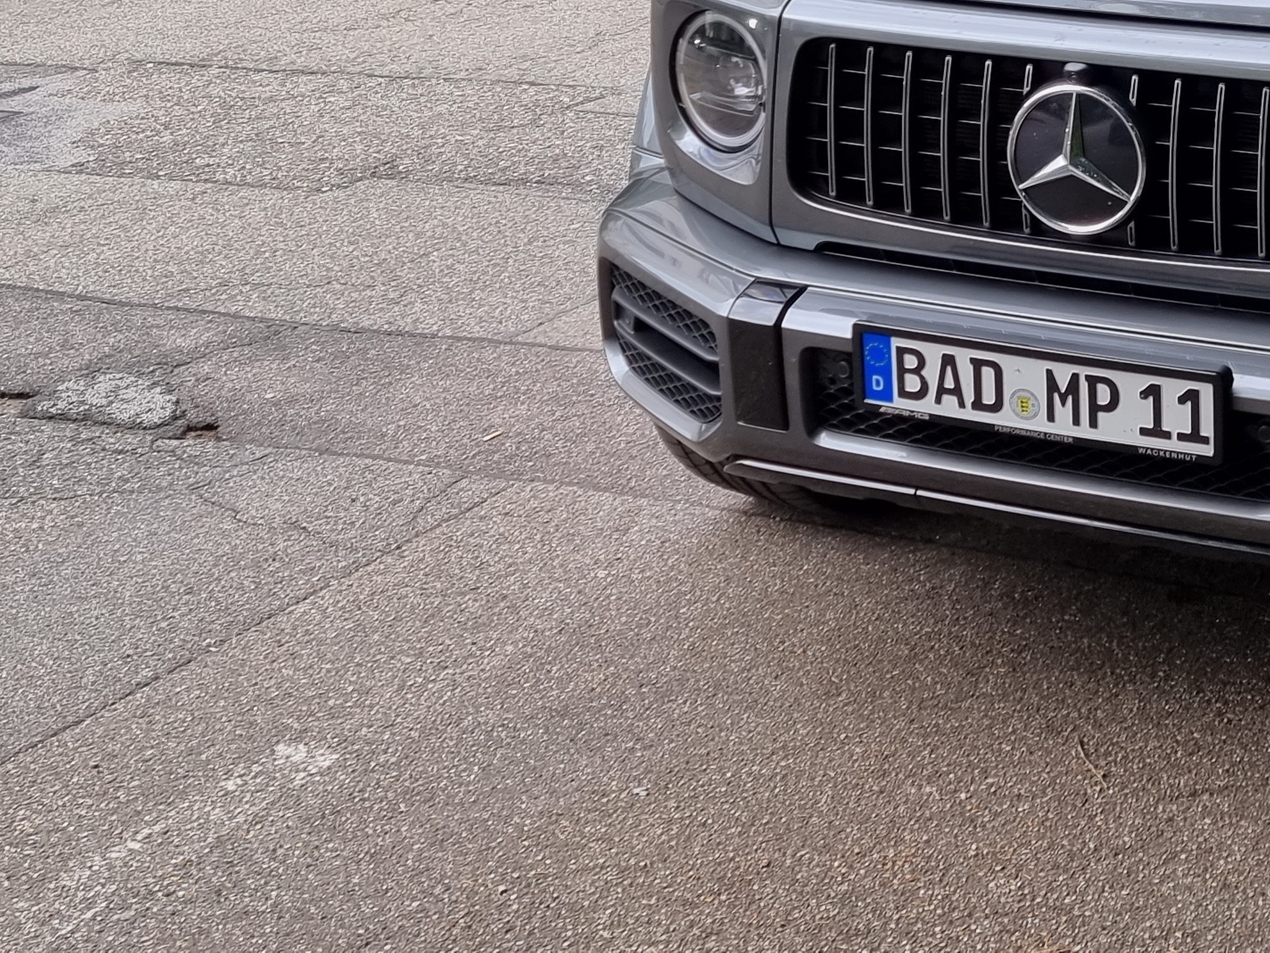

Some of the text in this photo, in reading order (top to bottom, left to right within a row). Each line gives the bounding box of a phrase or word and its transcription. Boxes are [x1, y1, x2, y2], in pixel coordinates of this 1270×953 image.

[872, 374, 884, 391] D
[895, 345, 1210, 446] BAD MP 11
[994, 425, 1074, 443] PERFORMANCE CENTER
[1137, 447, 1197, 461] WACKENHUT
